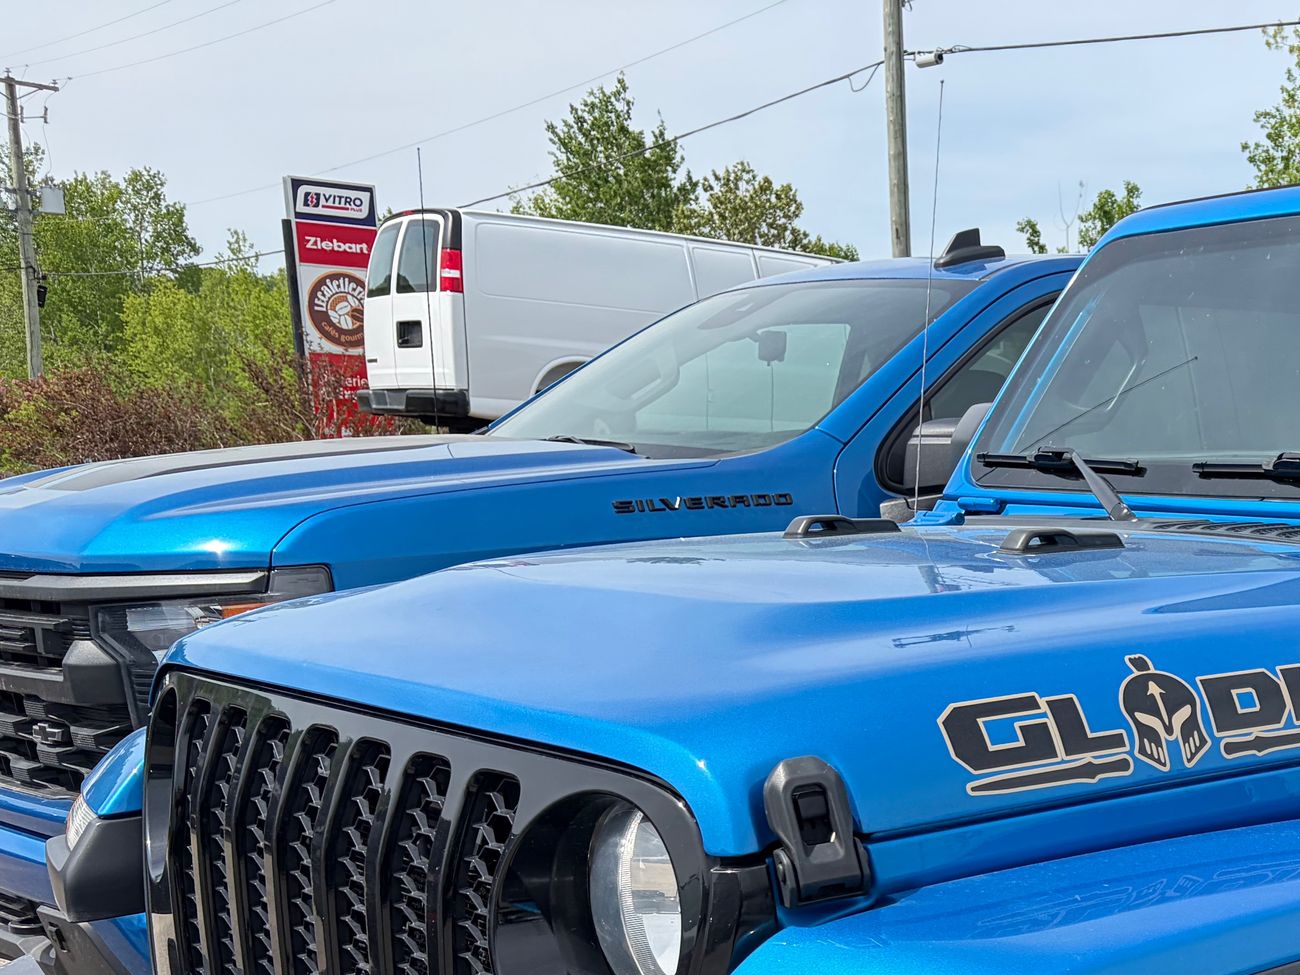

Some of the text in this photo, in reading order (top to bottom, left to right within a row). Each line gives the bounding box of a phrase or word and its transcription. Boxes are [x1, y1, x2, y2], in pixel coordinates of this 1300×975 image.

[322, 193, 363, 208] VITRO
[304, 235, 369, 255] Ziebart
[340, 331, 364, 342] gourm
[612, 492, 793, 514] SILVERADO
